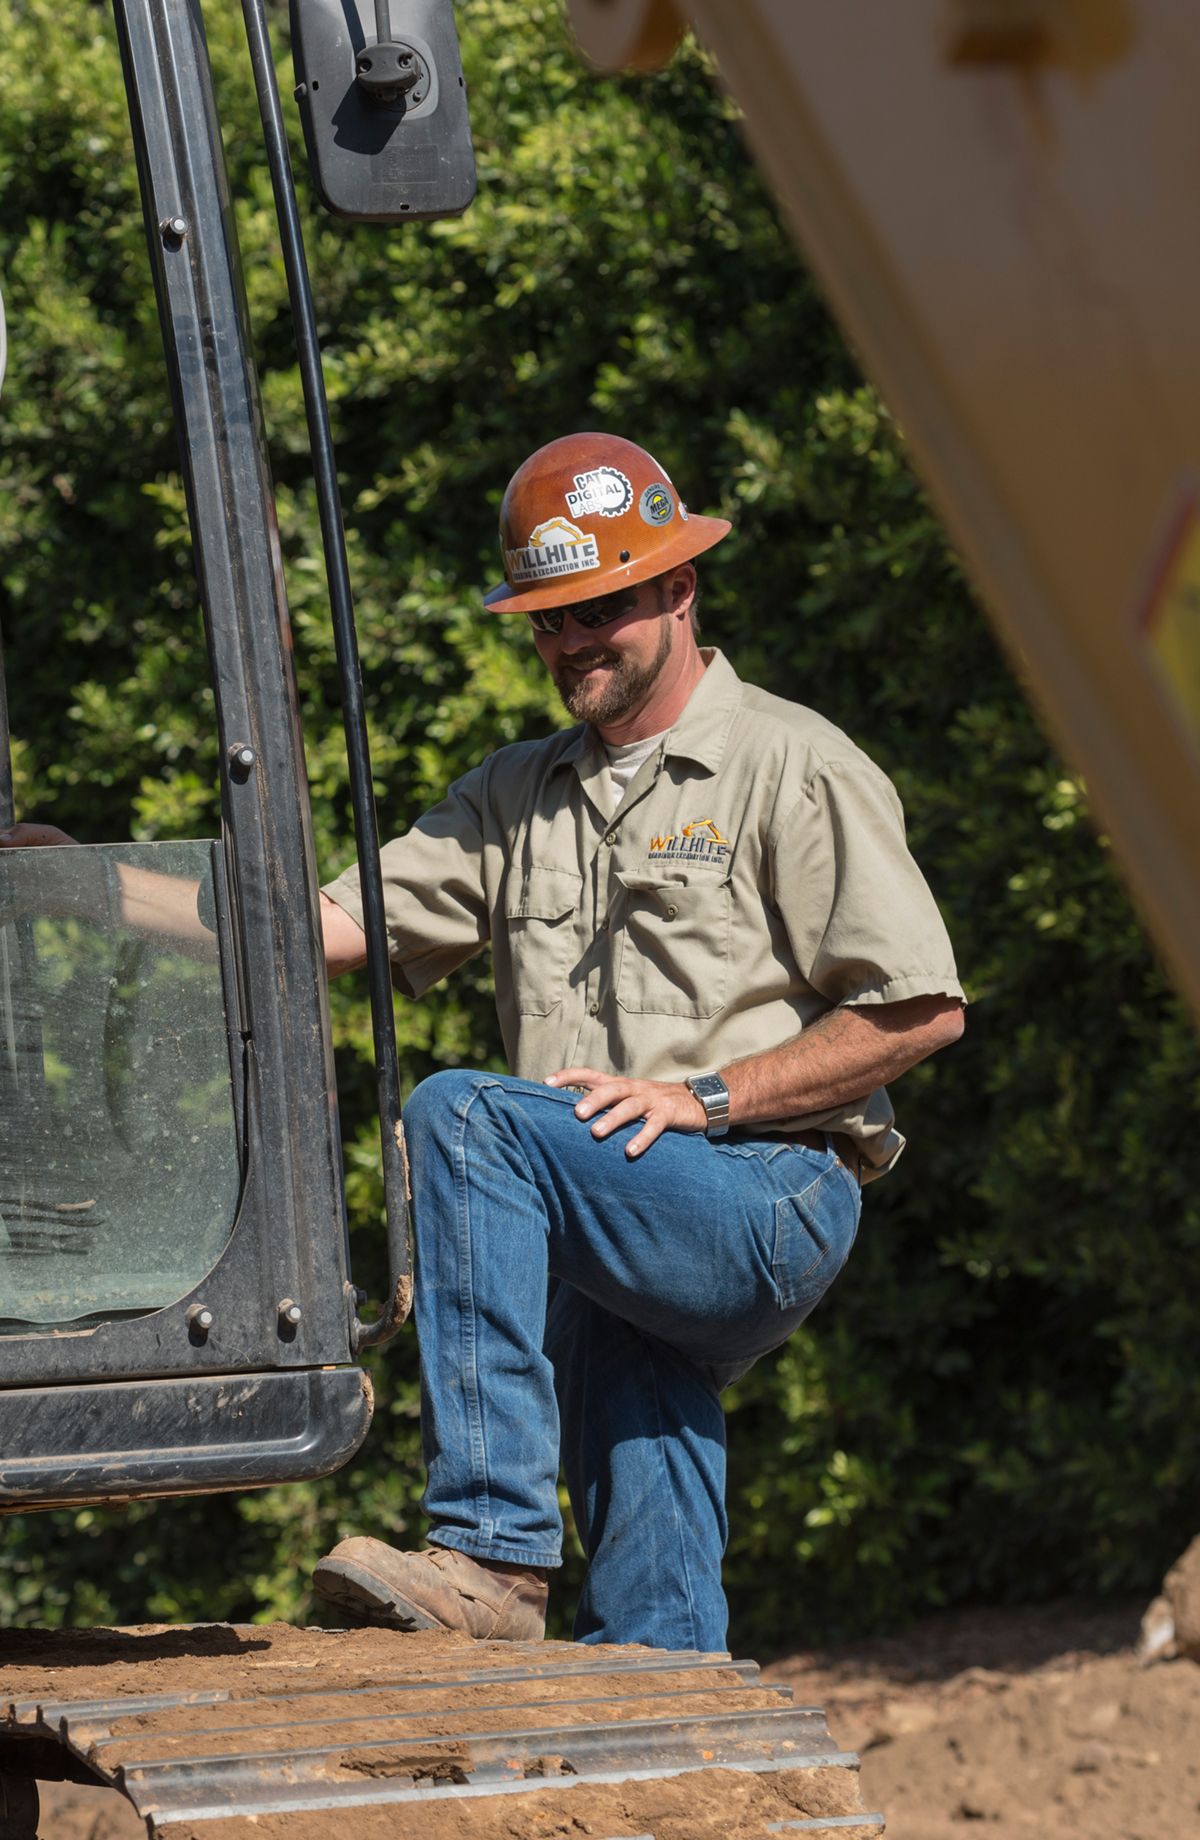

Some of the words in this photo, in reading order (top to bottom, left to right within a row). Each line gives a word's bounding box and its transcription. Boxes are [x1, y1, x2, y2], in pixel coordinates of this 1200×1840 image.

[575, 472, 602, 490] CAT
[567, 483, 622, 505] DIGITAL
[572, 499, 604, 516] LABS
[506, 540, 596, 571] WILLHITE
[538, 561, 580, 577] EXCAVATION
[650, 836, 728, 855] WILLHITE
